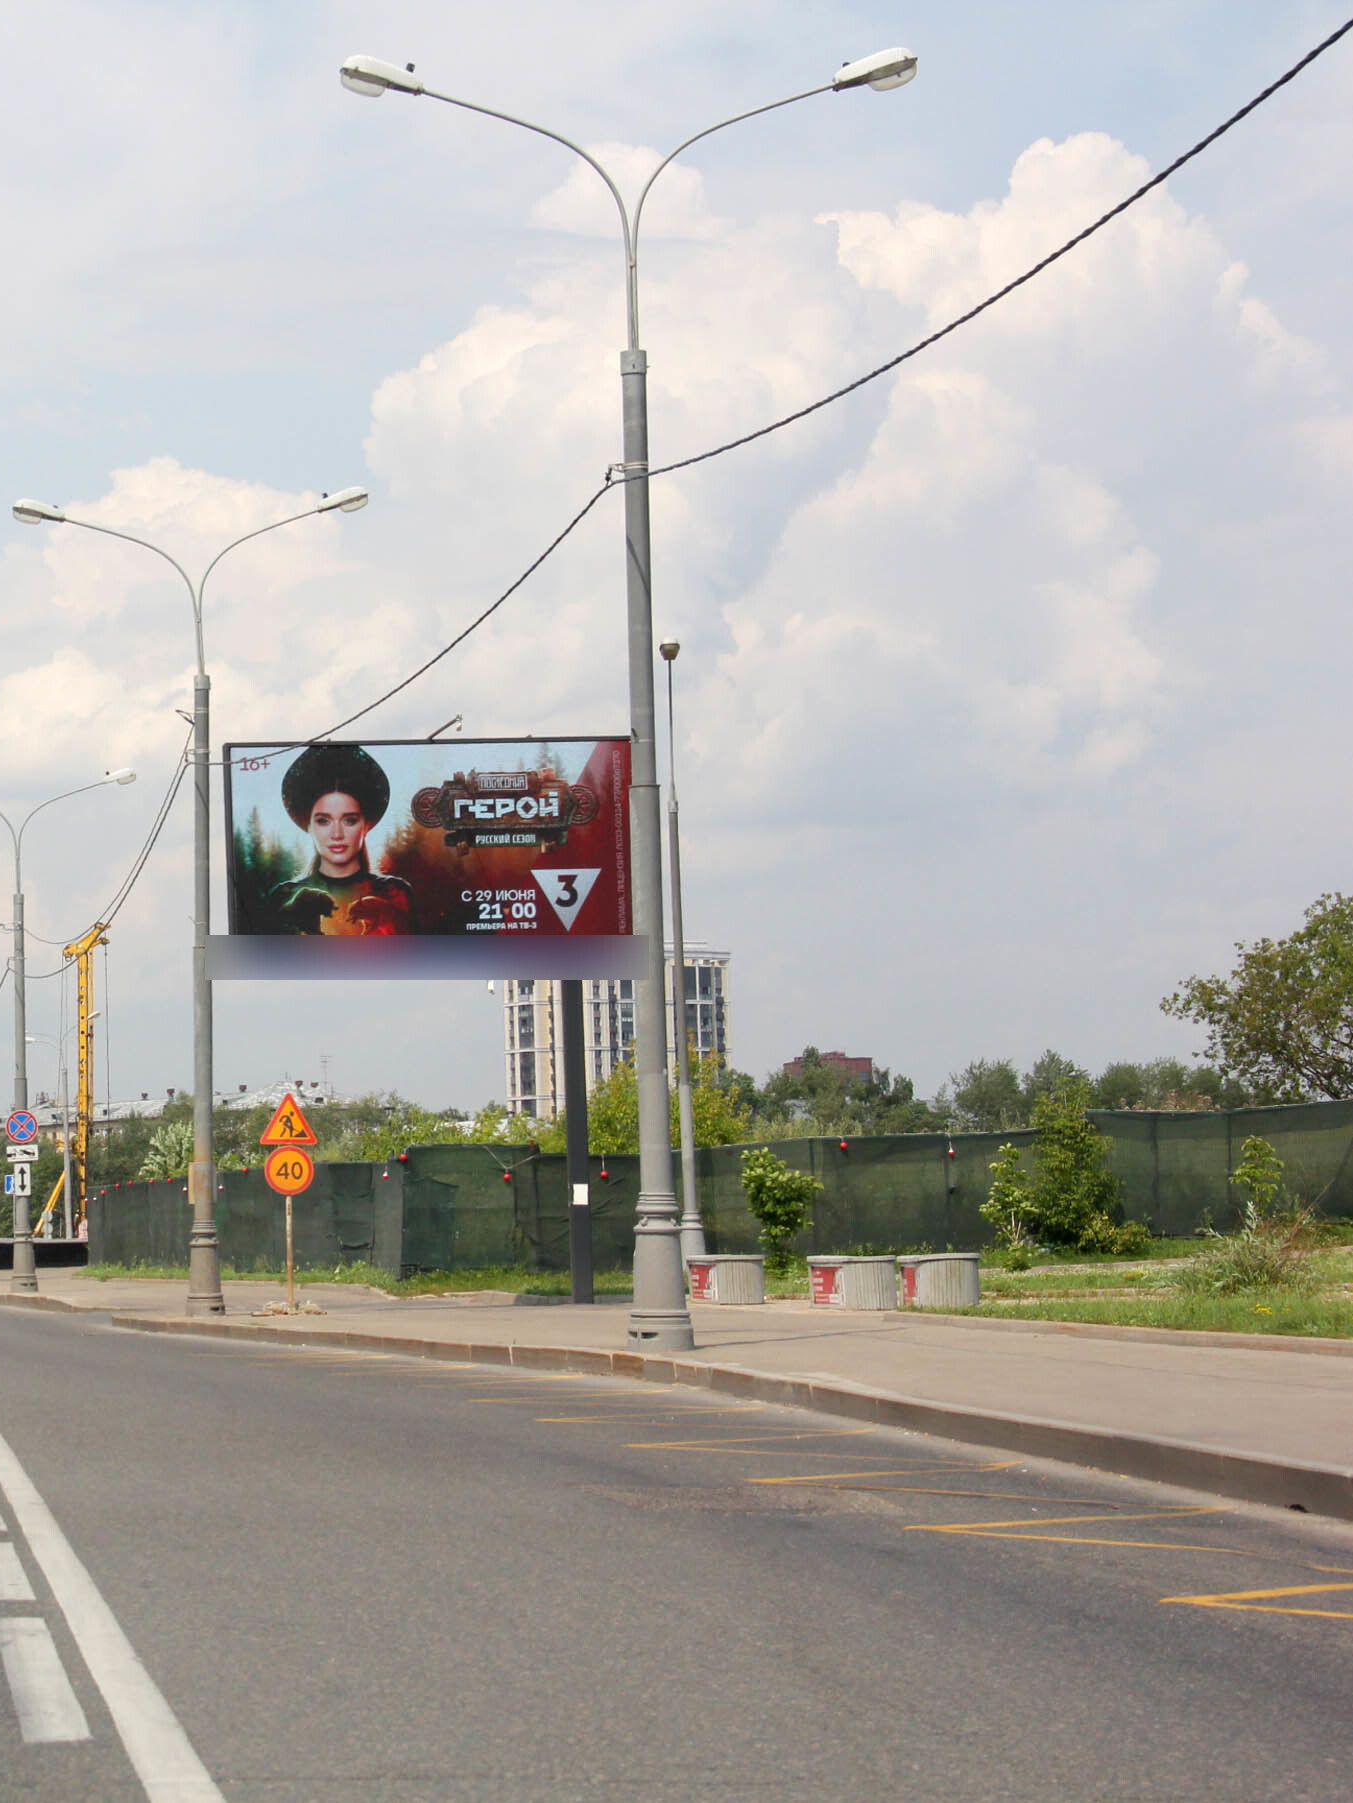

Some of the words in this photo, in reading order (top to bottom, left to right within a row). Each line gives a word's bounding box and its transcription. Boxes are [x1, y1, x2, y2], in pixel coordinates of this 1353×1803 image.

[240, 756, 271, 771] 16+
[454, 792, 559, 819] ГЕРОЙ
[475, 833, 510, 845] РУССКИЙ
[512, 834, 536, 844] СЕЗОН
[461, 890, 472, 902] С
[475, 890, 492, 901] 29
[495, 889, 536, 901] ИЮНЯ
[555, 874, 579, 908] 3
[276, 1162, 304, 1180] 40
